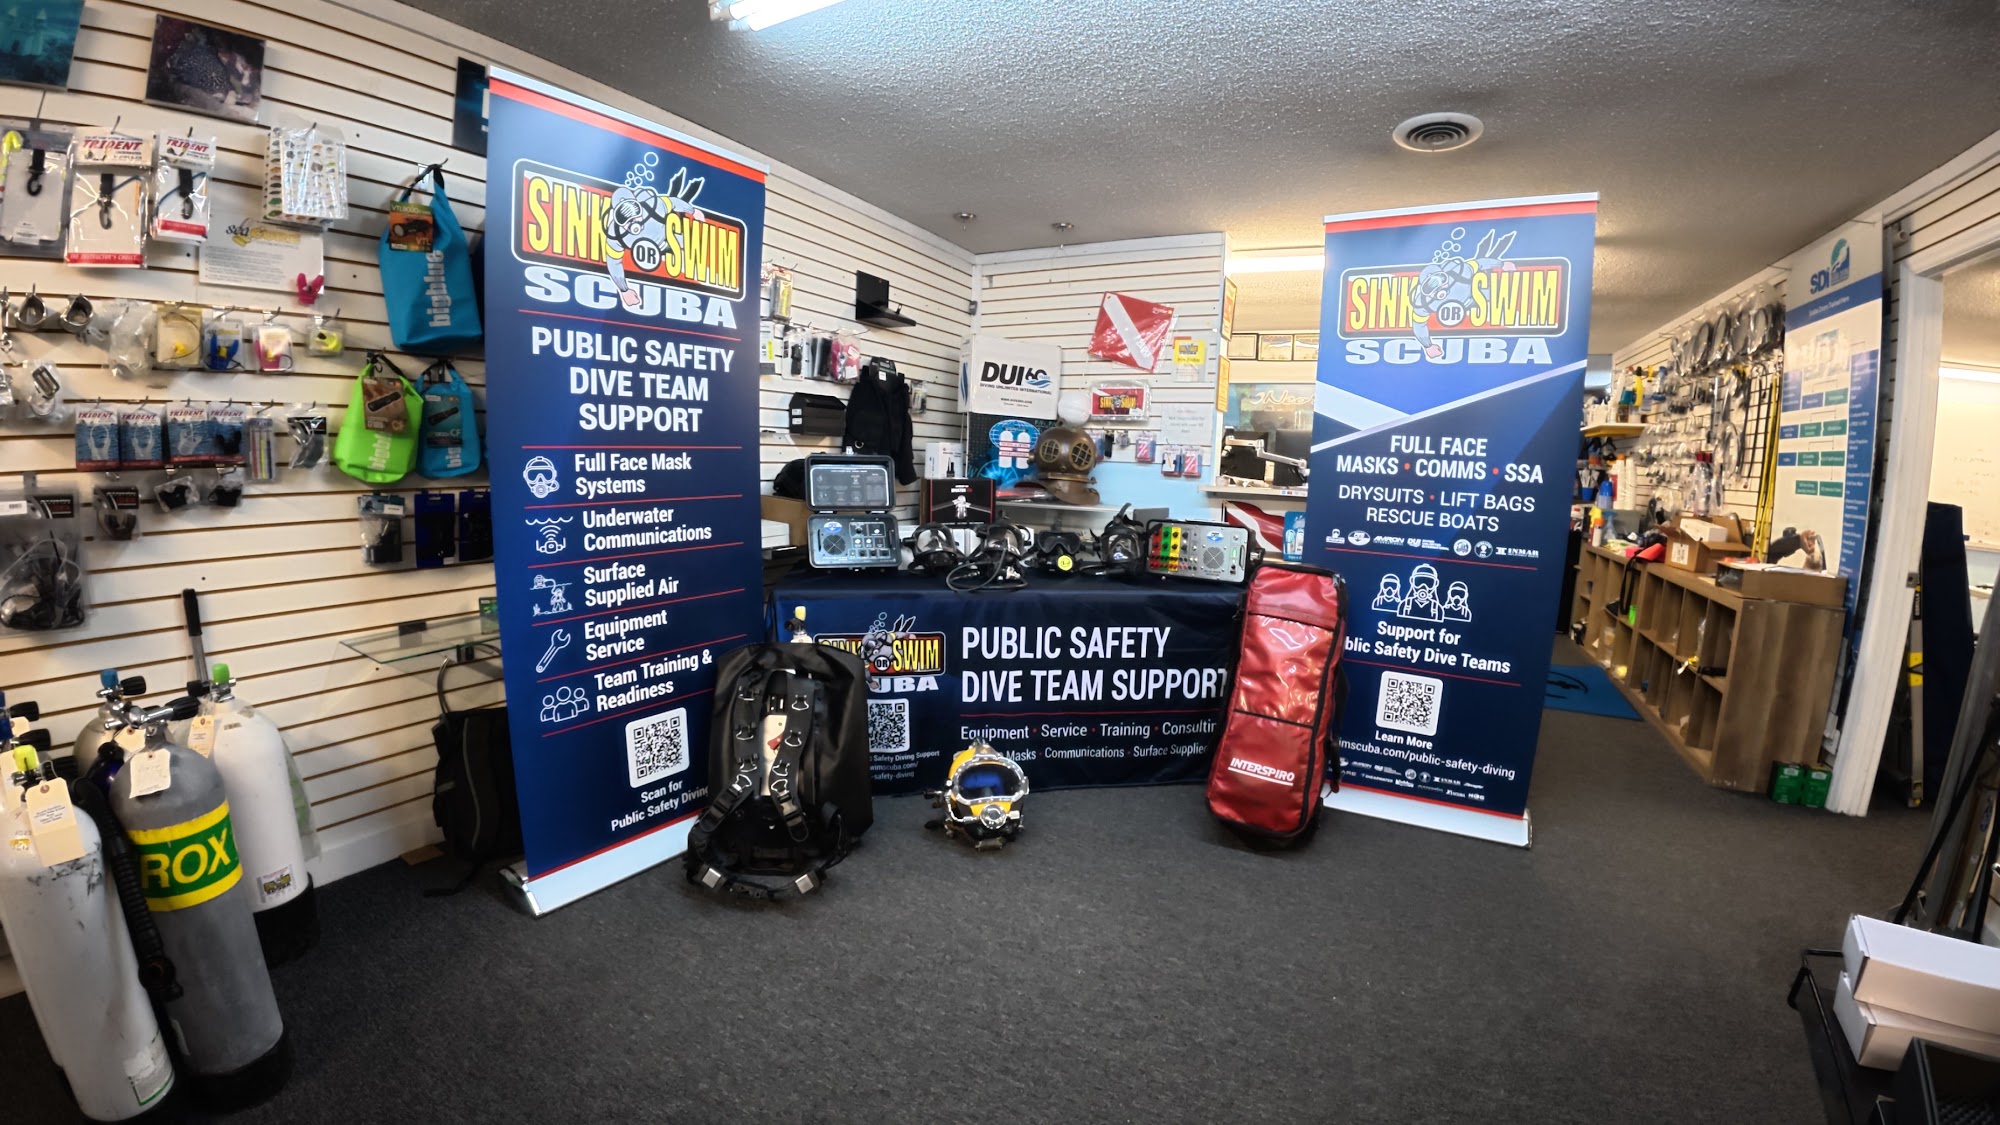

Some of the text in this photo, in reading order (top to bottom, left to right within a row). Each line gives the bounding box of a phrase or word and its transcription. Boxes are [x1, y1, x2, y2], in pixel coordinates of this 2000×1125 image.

[83, 139, 143, 151] TRIDENT
[166, 138, 209, 153] TRIDENT
[528, 175, 738, 289] SINK OR SWIM
[425, 249, 452, 328] bigblue
[524, 266, 738, 329] SCUBA
[1350, 270, 1558, 331] SINK OR SWIM
[532, 326, 735, 374] PUBLIC SAFETY
[1345, 337, 1553, 365] SCUBA
[569, 367, 709, 402] DIVE TEAM
[980, 361, 1025, 386] DUI
[1019, 387, 1053, 396] INTERNATIONAL
[579, 403, 703, 433] SUPPORT
[1391, 435, 1488, 457] FULL FACE
[575, 452, 692, 472] Full Face Mask
[1336, 455, 1544, 484] MASKS COMMS SSA
[575, 477, 646, 500] Systems
[1338, 484, 1536, 513] DRYSUITS LIFT BAGS
[583, 507, 674, 529] Underwater
[1366, 507, 1499, 532] RESCUE BOATS
[584, 524, 712, 552] Communications
[1373, 535, 1405, 544] AMRON
[1508, 547, 1539, 556] INMAR
[584, 562, 646, 585] Surface
[584, 577, 679, 609] Supplied Air
[584, 609, 668, 641] Equipment
[1377, 620, 1461, 646] Support for
[586, 635, 645, 661] Service
[876, 639, 939, 672] OR SWIM
[962, 626, 1172, 660] PUBLIC SAFETY
[1345, 637, 1511, 674] blic Safety Dive Teams
[594, 648, 713, 691] Team Training &
[596, 680, 675, 712] Readiness
[870, 676, 939, 694] UBA
[961, 667, 1228, 703] DIVE TEAM SUPPORT
[961, 719, 1217, 743] Equipment Service Training Consulti
[1375, 730, 1433, 750] Learn More
[870, 761, 919, 771] wimscuba.com/
[873, 750, 940, 763] Safety Diving Support
[1006, 748, 1037, 762] Masks
[1044, 745, 1125, 760] Communications
[1133, 744, 1168, 758] Surface
[1339, 736, 1516, 781] imscuba.com/public-safety-diving
[871, 771, 915, 781] -safety-diving
[1229, 757, 1296, 781] INTERSPIRO
[640, 780, 683, 804] Scan for
[611, 811, 646, 832] Public
[647, 797, 680, 818] Safety
